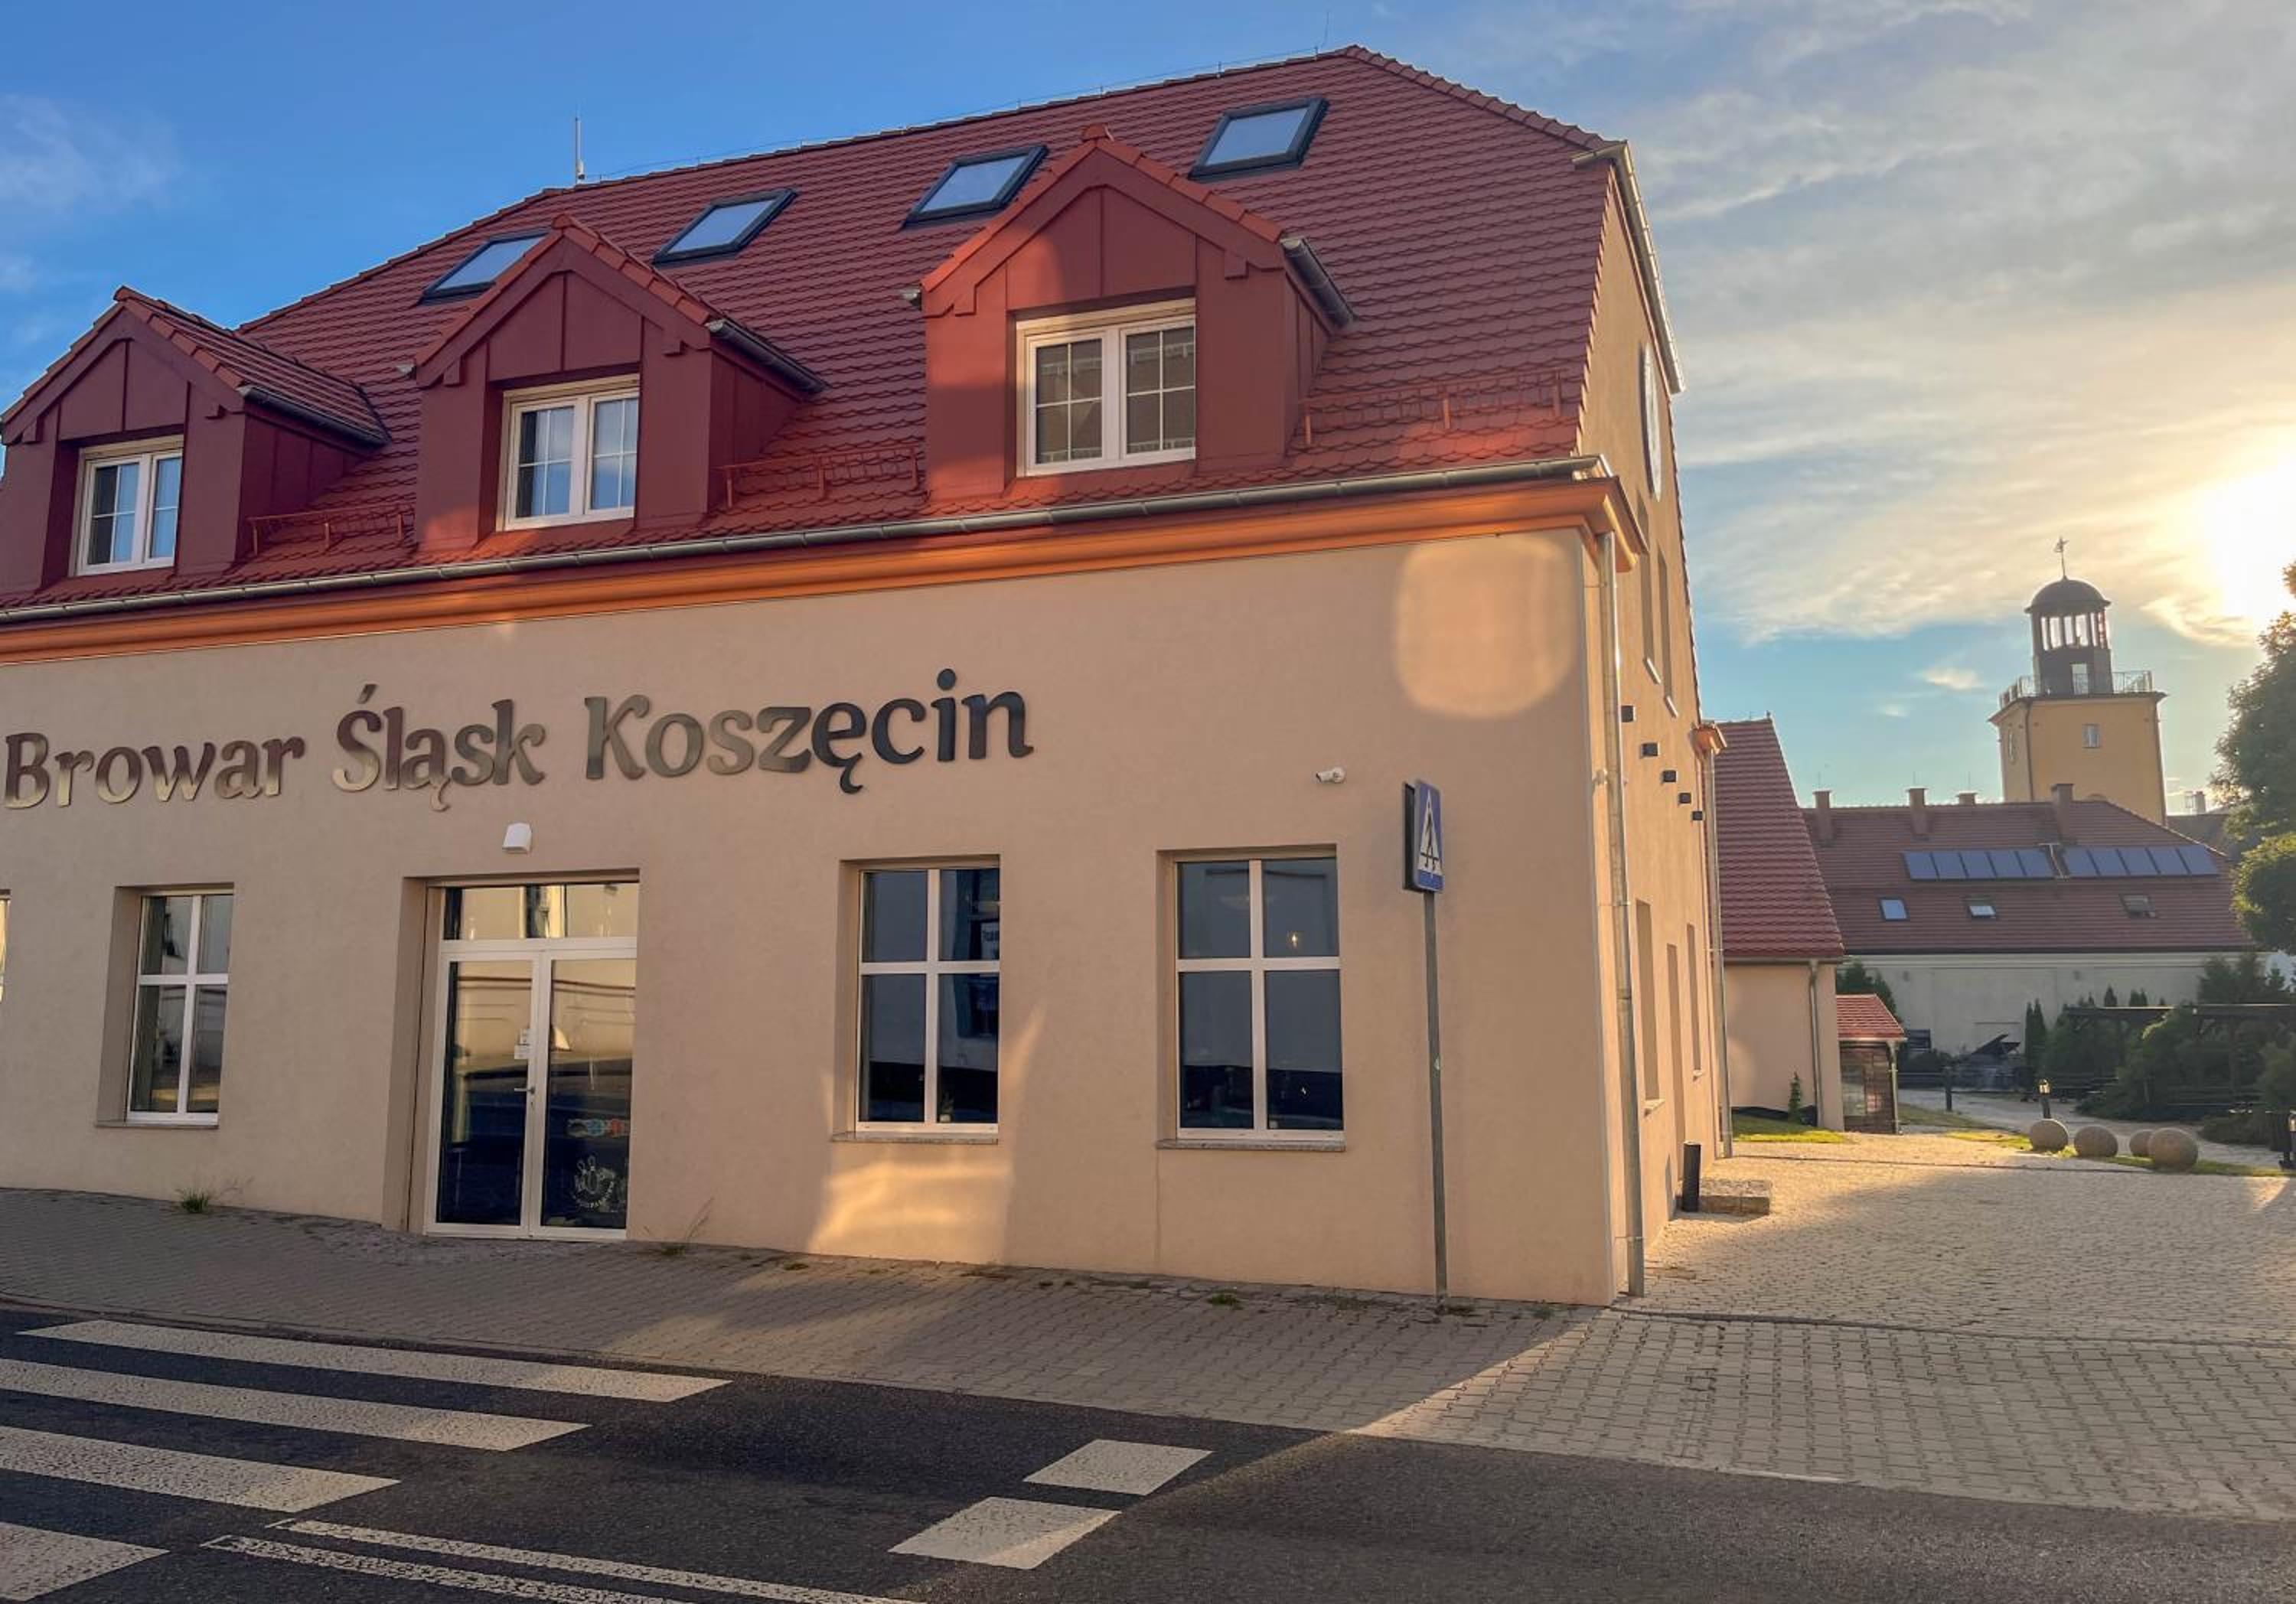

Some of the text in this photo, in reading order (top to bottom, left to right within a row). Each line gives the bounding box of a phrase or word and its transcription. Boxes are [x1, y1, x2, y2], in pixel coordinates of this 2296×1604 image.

[5, 668, 1035, 813] Browar Śląsk Koszęcin
